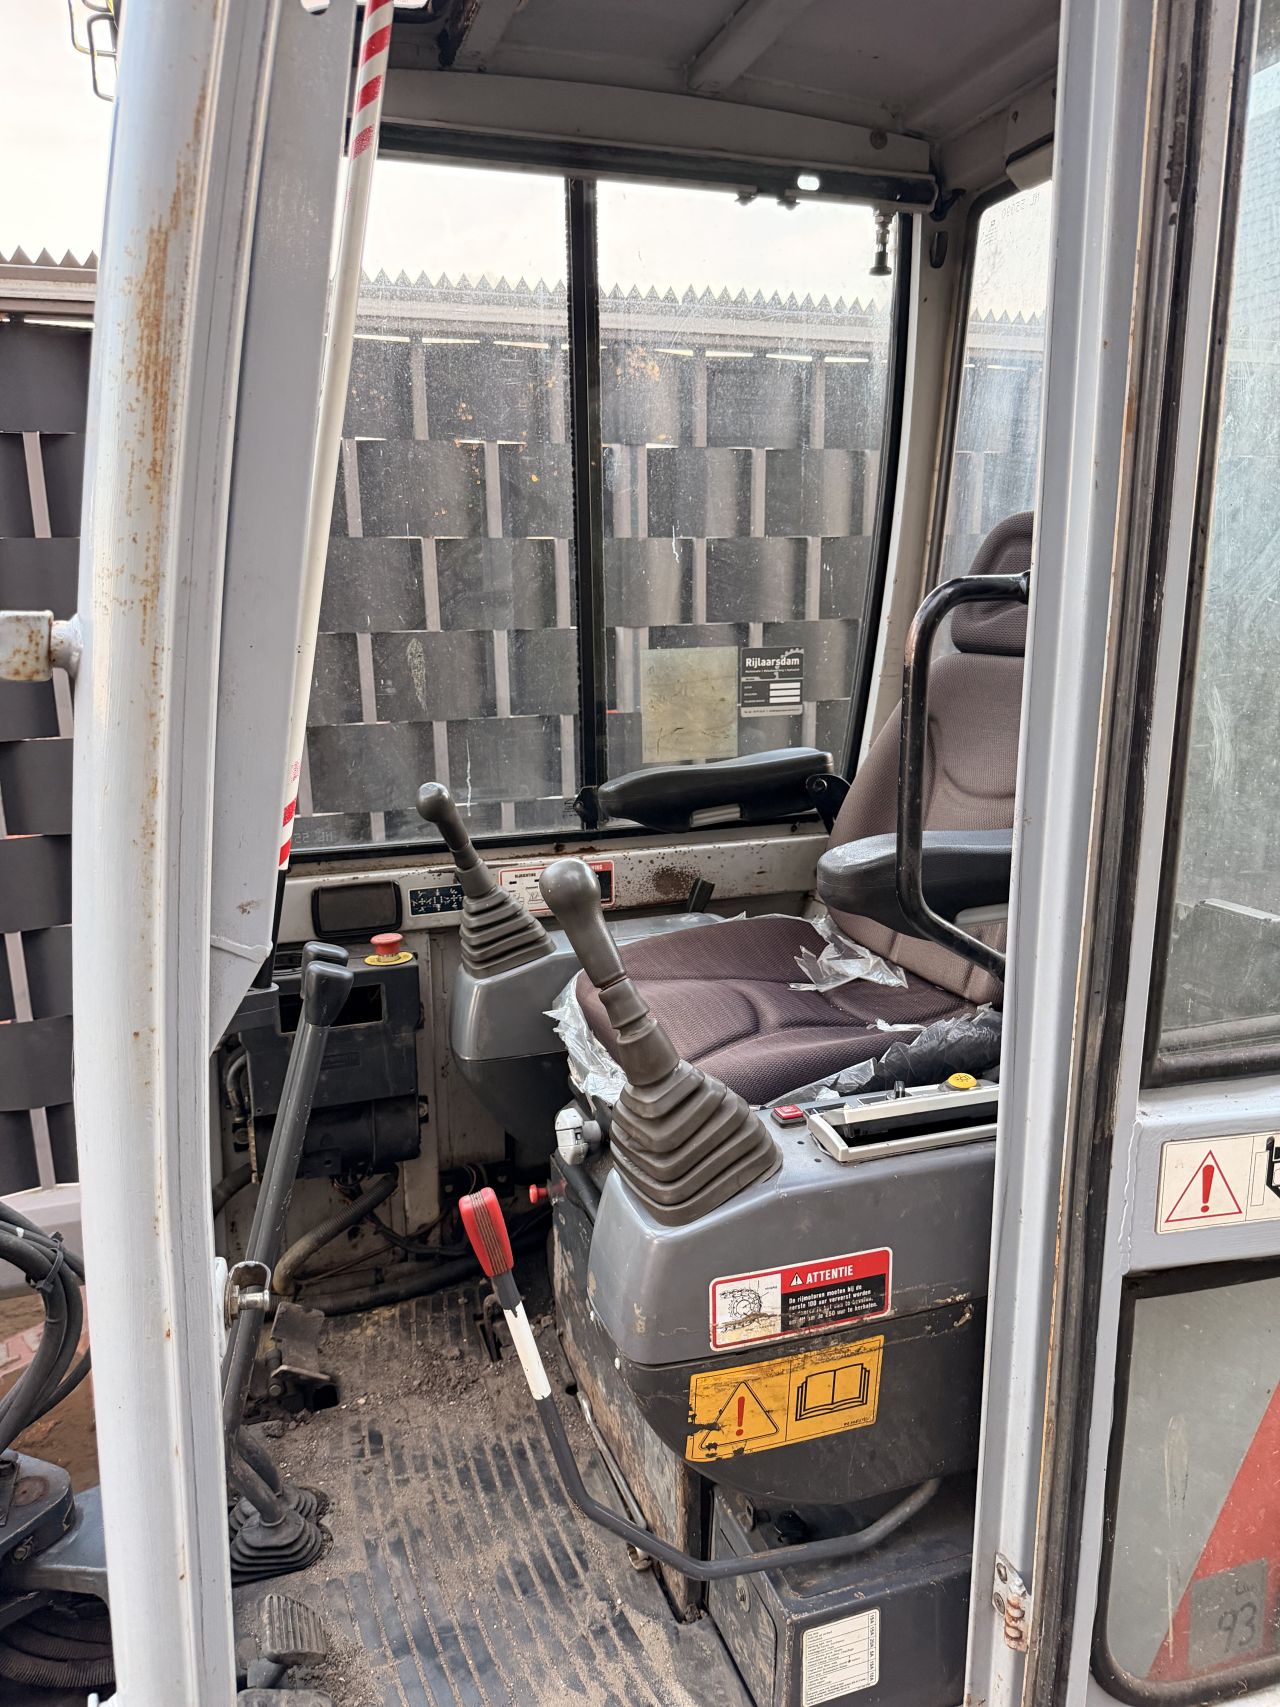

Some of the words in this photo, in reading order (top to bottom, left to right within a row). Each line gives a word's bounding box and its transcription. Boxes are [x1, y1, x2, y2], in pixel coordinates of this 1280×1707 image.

[745, 657, 800, 669] Rijlaarsdam
[806, 1265, 854, 1284] ATTENTIE
[825, 1310, 836, 1318] 250
[1218, 1602, 1257, 1653] 93
